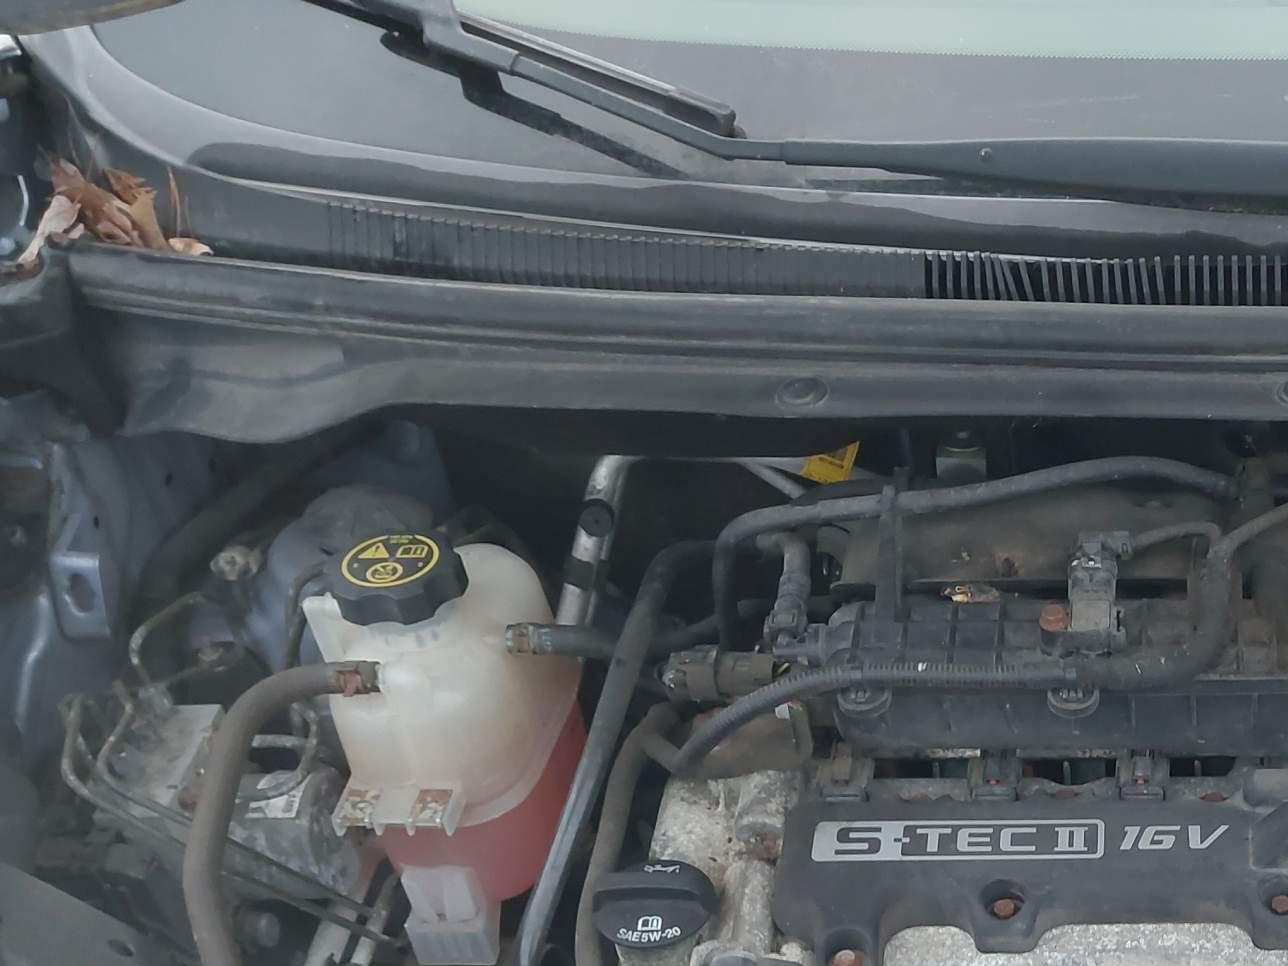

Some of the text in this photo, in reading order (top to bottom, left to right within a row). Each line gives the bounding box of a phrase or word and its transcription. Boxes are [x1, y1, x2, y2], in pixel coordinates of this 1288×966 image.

[833, 824, 1230, 855] S-TEC II 16V
